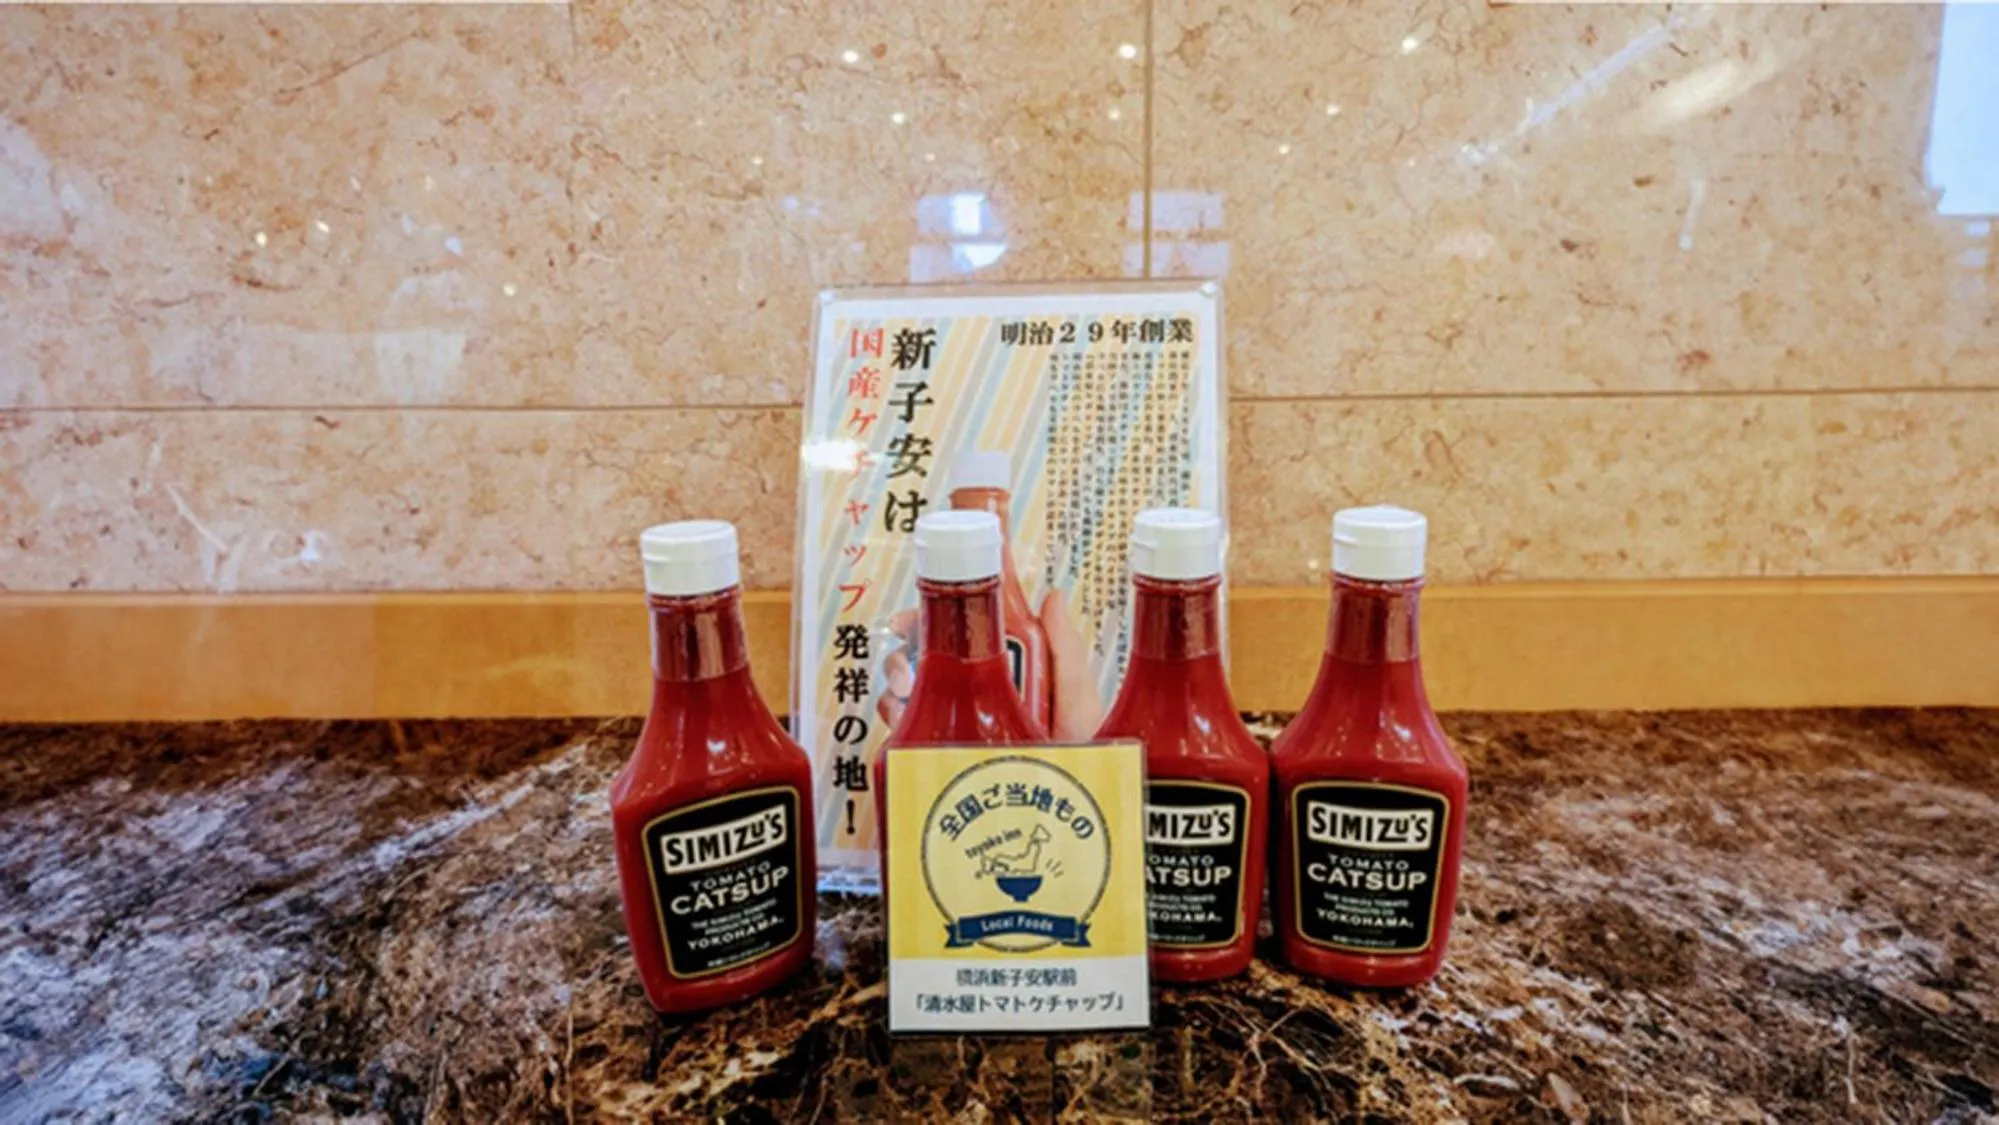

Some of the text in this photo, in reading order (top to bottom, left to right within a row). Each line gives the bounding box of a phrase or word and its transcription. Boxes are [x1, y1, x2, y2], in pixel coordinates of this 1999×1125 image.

[884, 327, 937, 533] 新子安は
[939, 782, 1095, 842] 全国ご当地もの
[1148, 809, 1231, 839] MIZU'S
[1149, 855, 1214, 868] OMATO
[1328, 853, 1409, 871] TOMATO
[690, 860, 770, 892] TOMATO
[1145, 866, 1232, 887] ATSUP
[1307, 862, 1427, 891] CATSUP
[670, 865, 789, 915] CATSUP
[981, 915, 1054, 932] Local Foods
[957, 968, 1077, 986] 横浜新子安駅前
[916, 992, 1124, 1013] 「清水屋トマトケチャップ」
